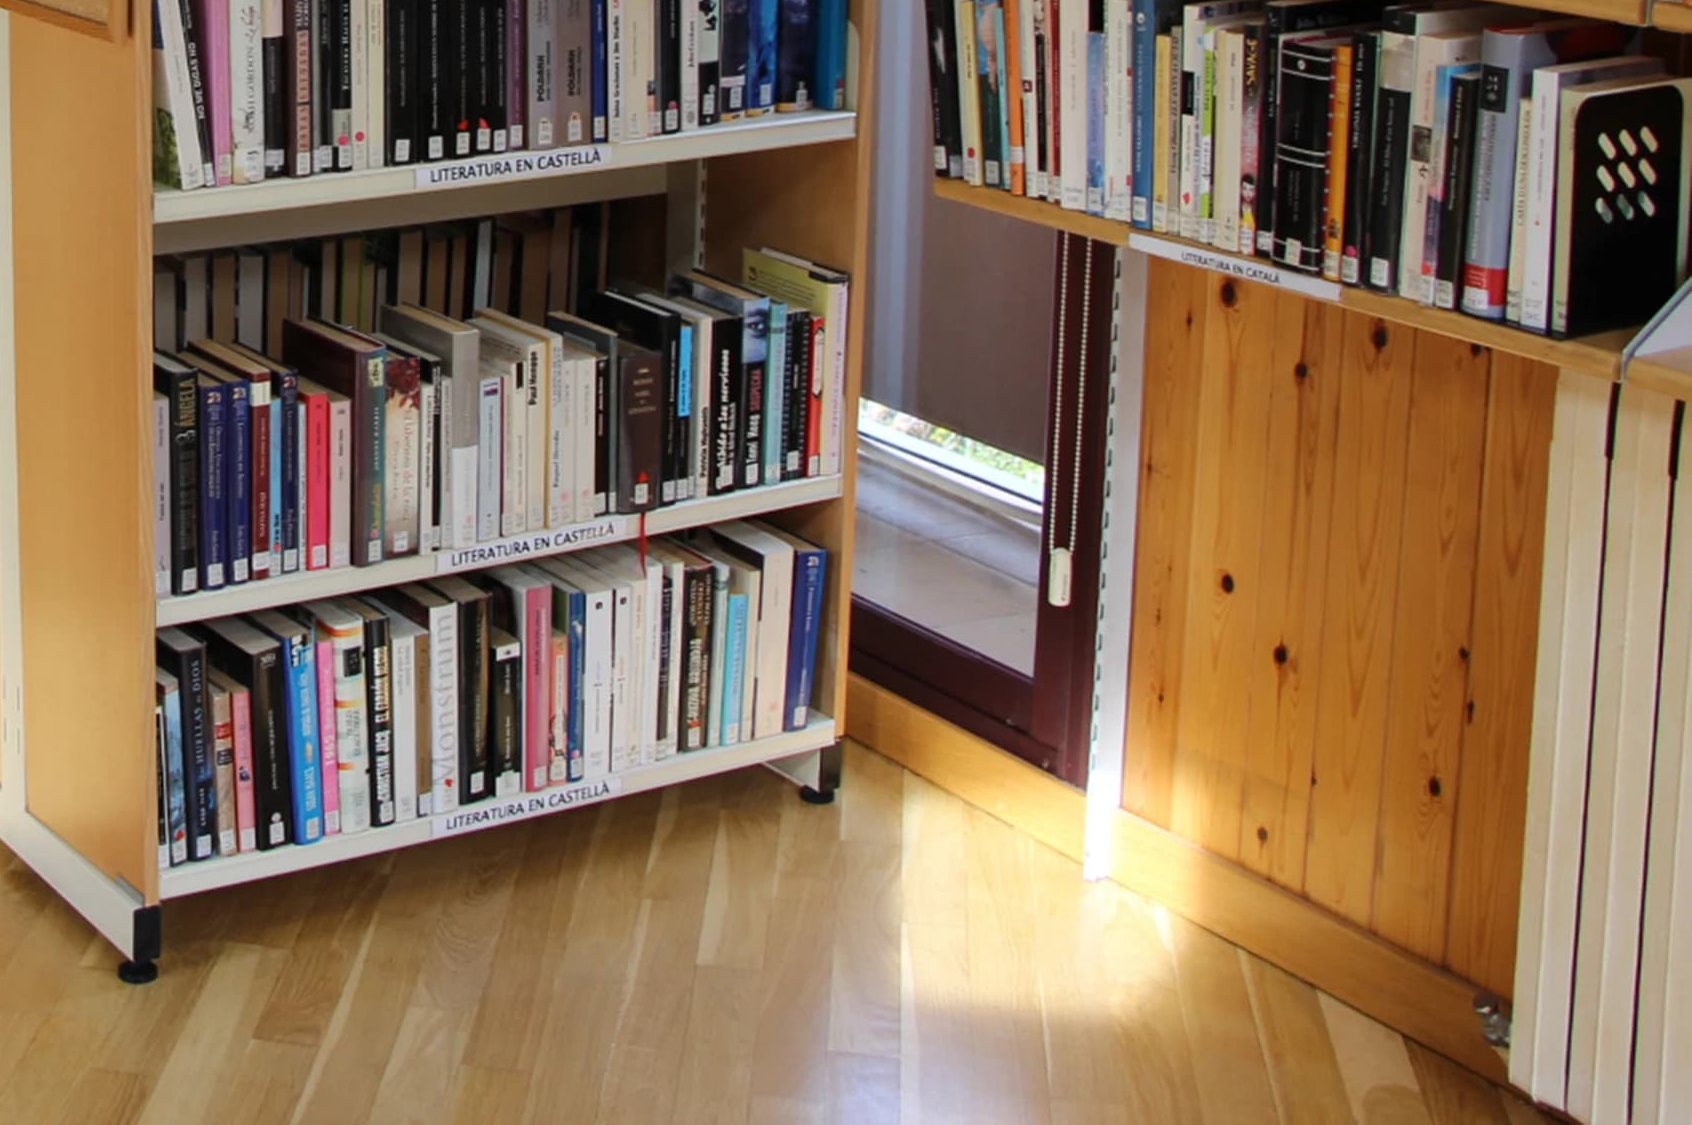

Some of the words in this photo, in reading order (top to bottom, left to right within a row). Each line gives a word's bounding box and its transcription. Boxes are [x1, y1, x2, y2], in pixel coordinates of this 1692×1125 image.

[536, 55, 546, 103] POLDARK
[567, 49, 577, 96] POLDARK
[1245, 39, 1259, 86] SAVAGE
[430, 161, 512, 183] LITERATURA
[516, 158, 533, 172] EN
[538, 147, 602, 170] CASTELLÀ
[1181, 250, 1231, 273] LITERATURA
[1232, 262, 1244, 275] EN
[1246, 265, 1280, 284] CATALÀ
[176, 380, 197, 428] ÁNGELA
[451, 539, 531, 567] LITERATURA
[535, 536, 551, 551] EN
[554, 524, 615, 547] CASTELLÀ
[191, 660, 202, 691] DIOS
[432, 613, 458, 783] Monstrum
[192, 707, 205, 763] HUELLAS
[376, 712, 388, 722] EL
[323, 735, 335, 766] 1965
[378, 730, 391, 752] JACQ
[446, 803, 525, 830] LITERATURA
[528, 798, 545, 813] EN
[548, 781, 611, 807] CASTELLÀ
